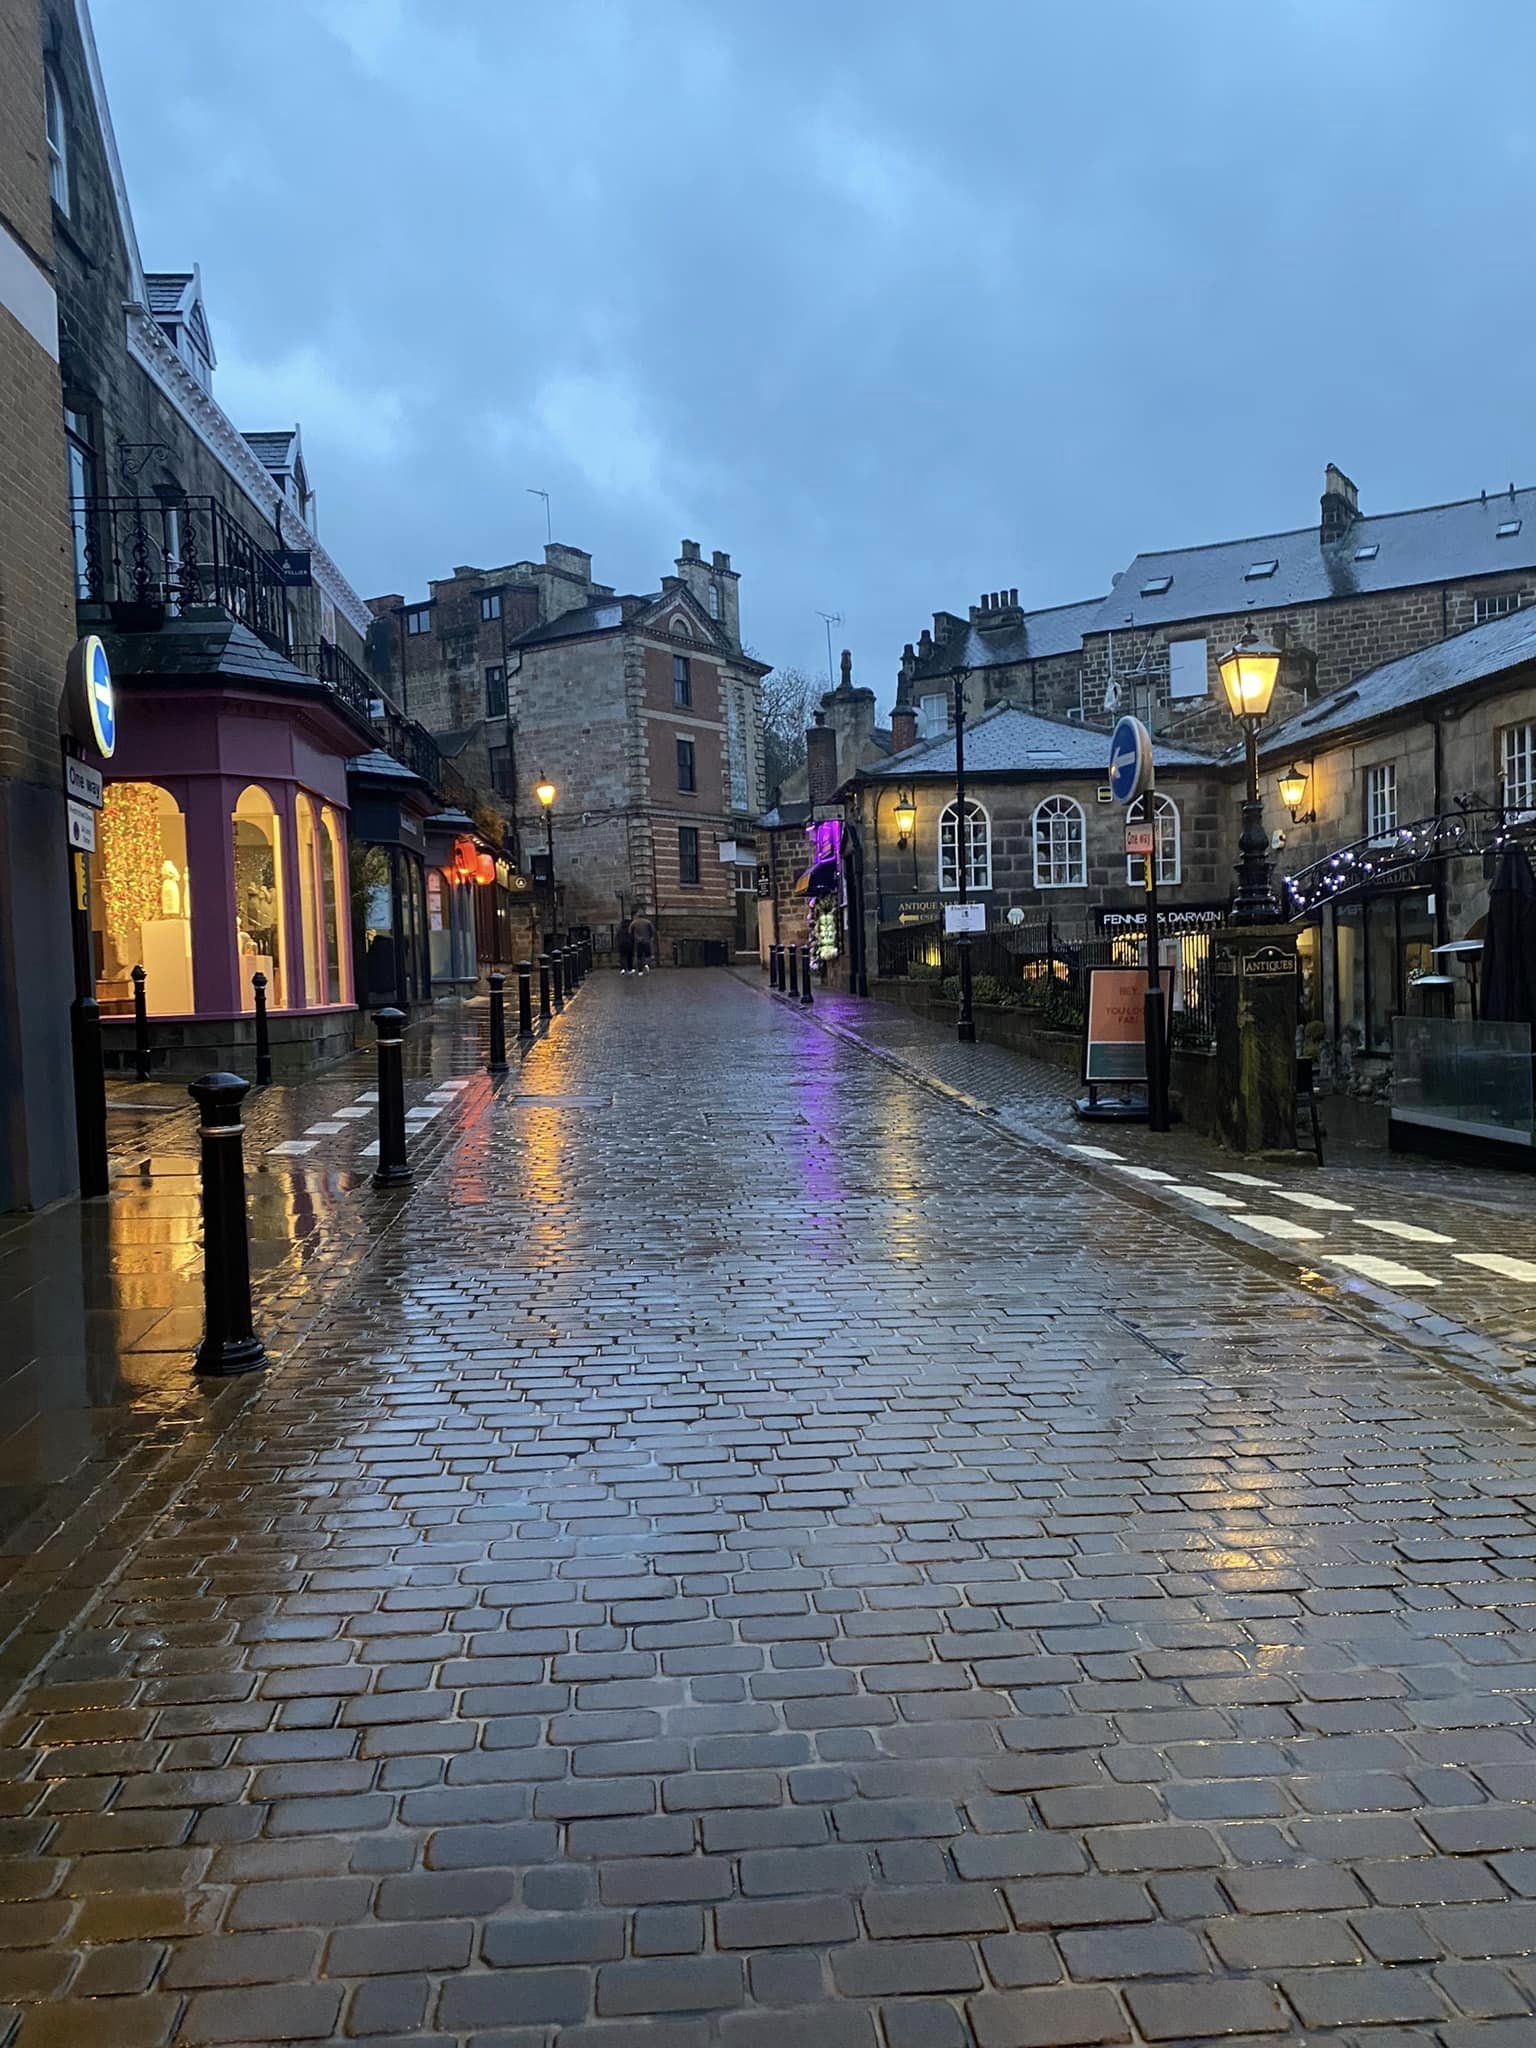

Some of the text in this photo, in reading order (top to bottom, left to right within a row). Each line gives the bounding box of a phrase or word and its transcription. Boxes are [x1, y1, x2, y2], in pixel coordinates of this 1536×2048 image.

[69, 765, 100, 800] One way
[1127, 831, 1151, 846] One way
[899, 902, 937, 911] ANTIQUE
[1157, 912, 1165, 923] &
[1168, 912, 1221, 923] DARWIN
[1246, 960, 1293, 972] ANTIQUES
